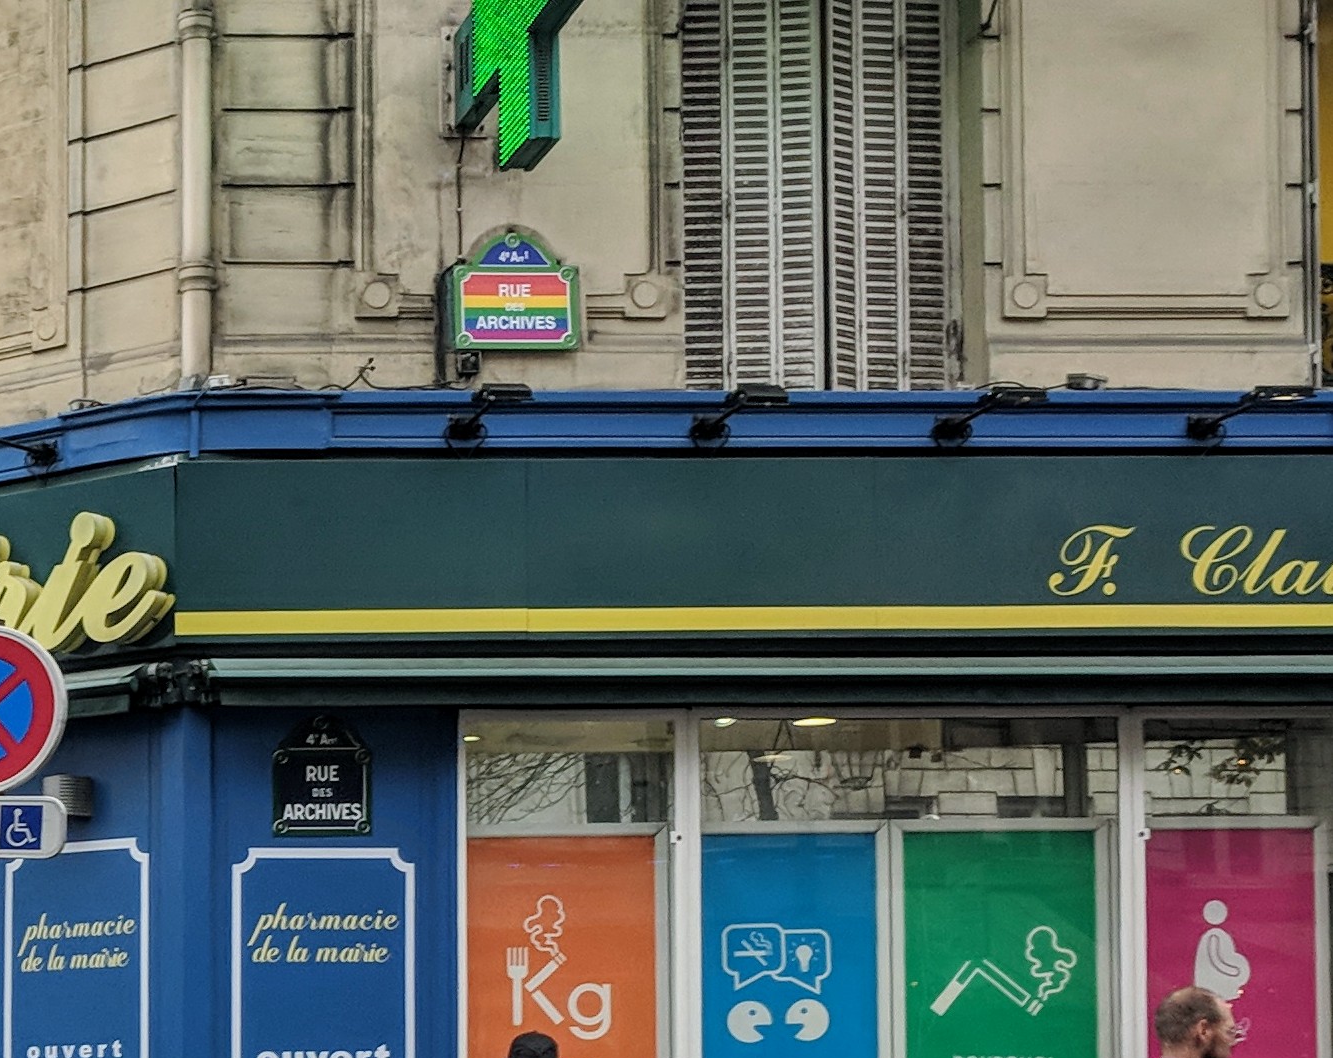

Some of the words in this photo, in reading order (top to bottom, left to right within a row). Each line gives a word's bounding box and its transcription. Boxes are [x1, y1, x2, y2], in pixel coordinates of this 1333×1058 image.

[498, 284, 531, 297] RUE
[475, 315, 557, 330] ARCHIVES
[1048, 524, 1138, 596] F.
[305, 765, 340, 782] RUE
[312, 788, 333, 797] DES
[282, 803, 362, 820] ARCHIVES
[17, 912, 136, 957] pharmacie
[247, 902, 399, 946] pharmacie
[21, 944, 44, 973] de
[47, 944, 65, 972] la
[69, 947, 128, 970] mairie
[252, 935, 281, 963] de
[285, 935, 309, 963] la
[315, 942, 391, 963] mairie
